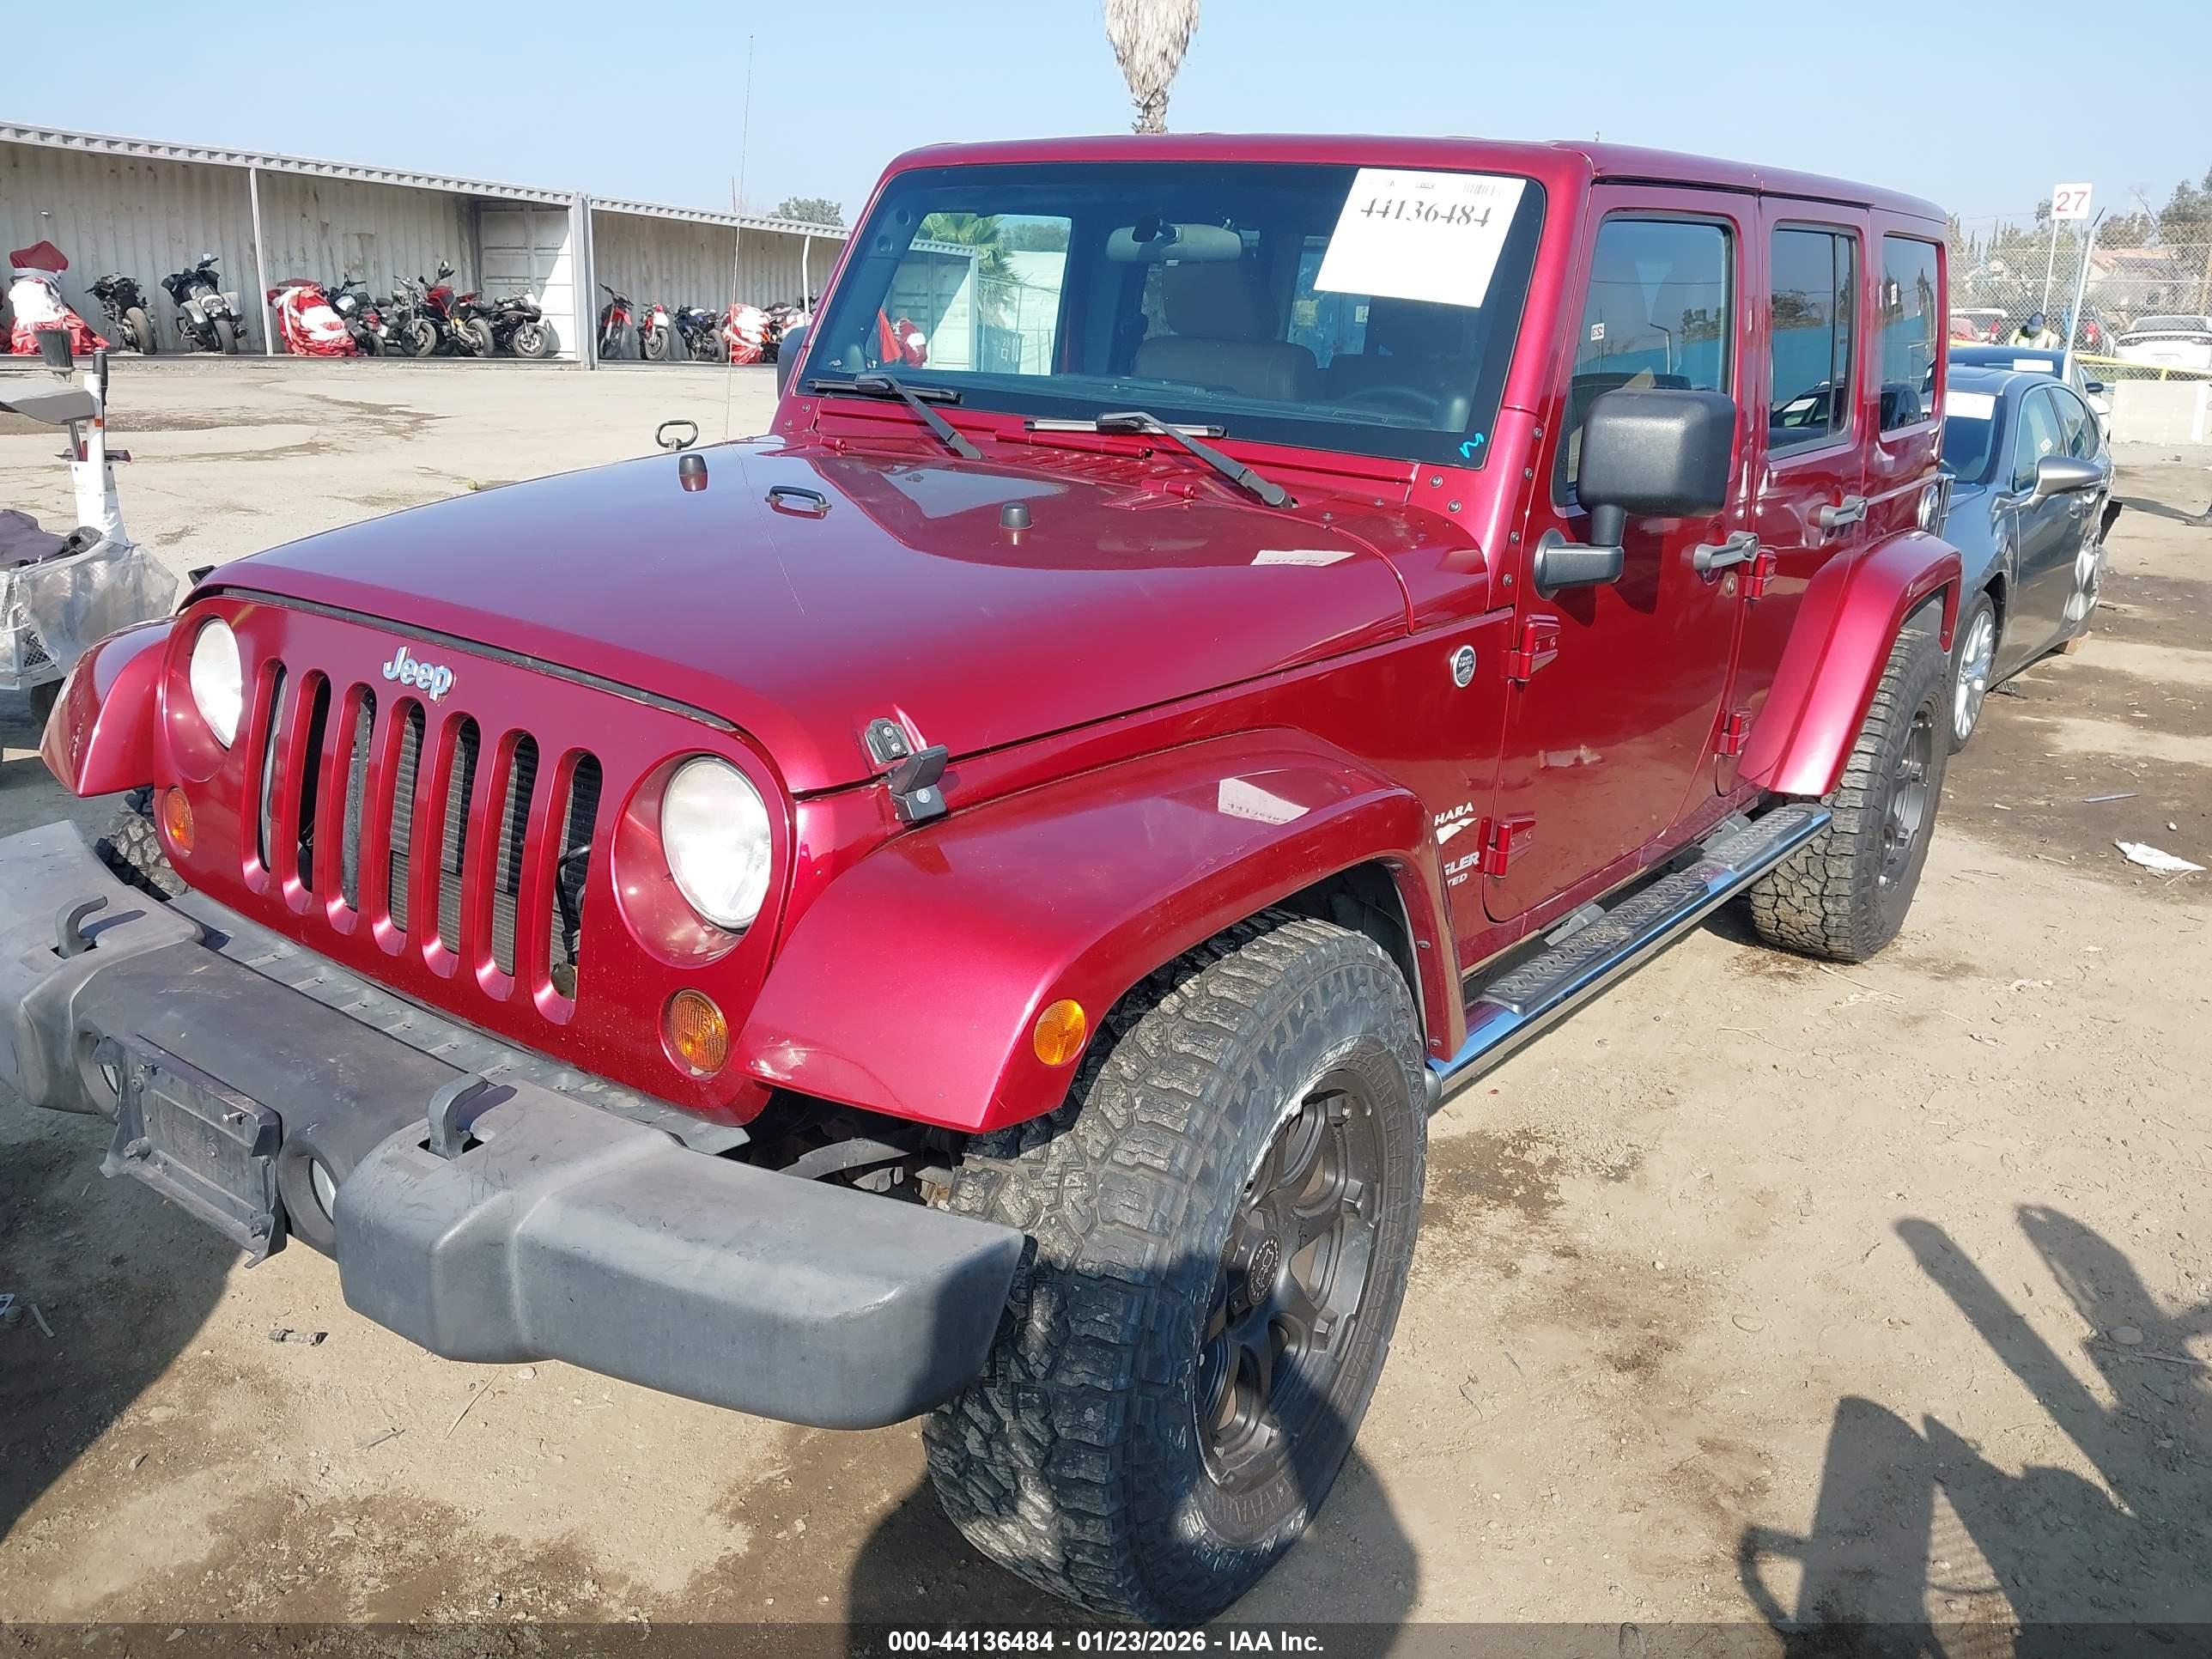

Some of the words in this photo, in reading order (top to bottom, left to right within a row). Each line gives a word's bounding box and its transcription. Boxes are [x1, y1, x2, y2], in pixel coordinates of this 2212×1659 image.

[1360, 198, 1492, 228] 44136484
[2055, 191, 2088, 212] 27
[382, 646, 454, 702] Jeep
